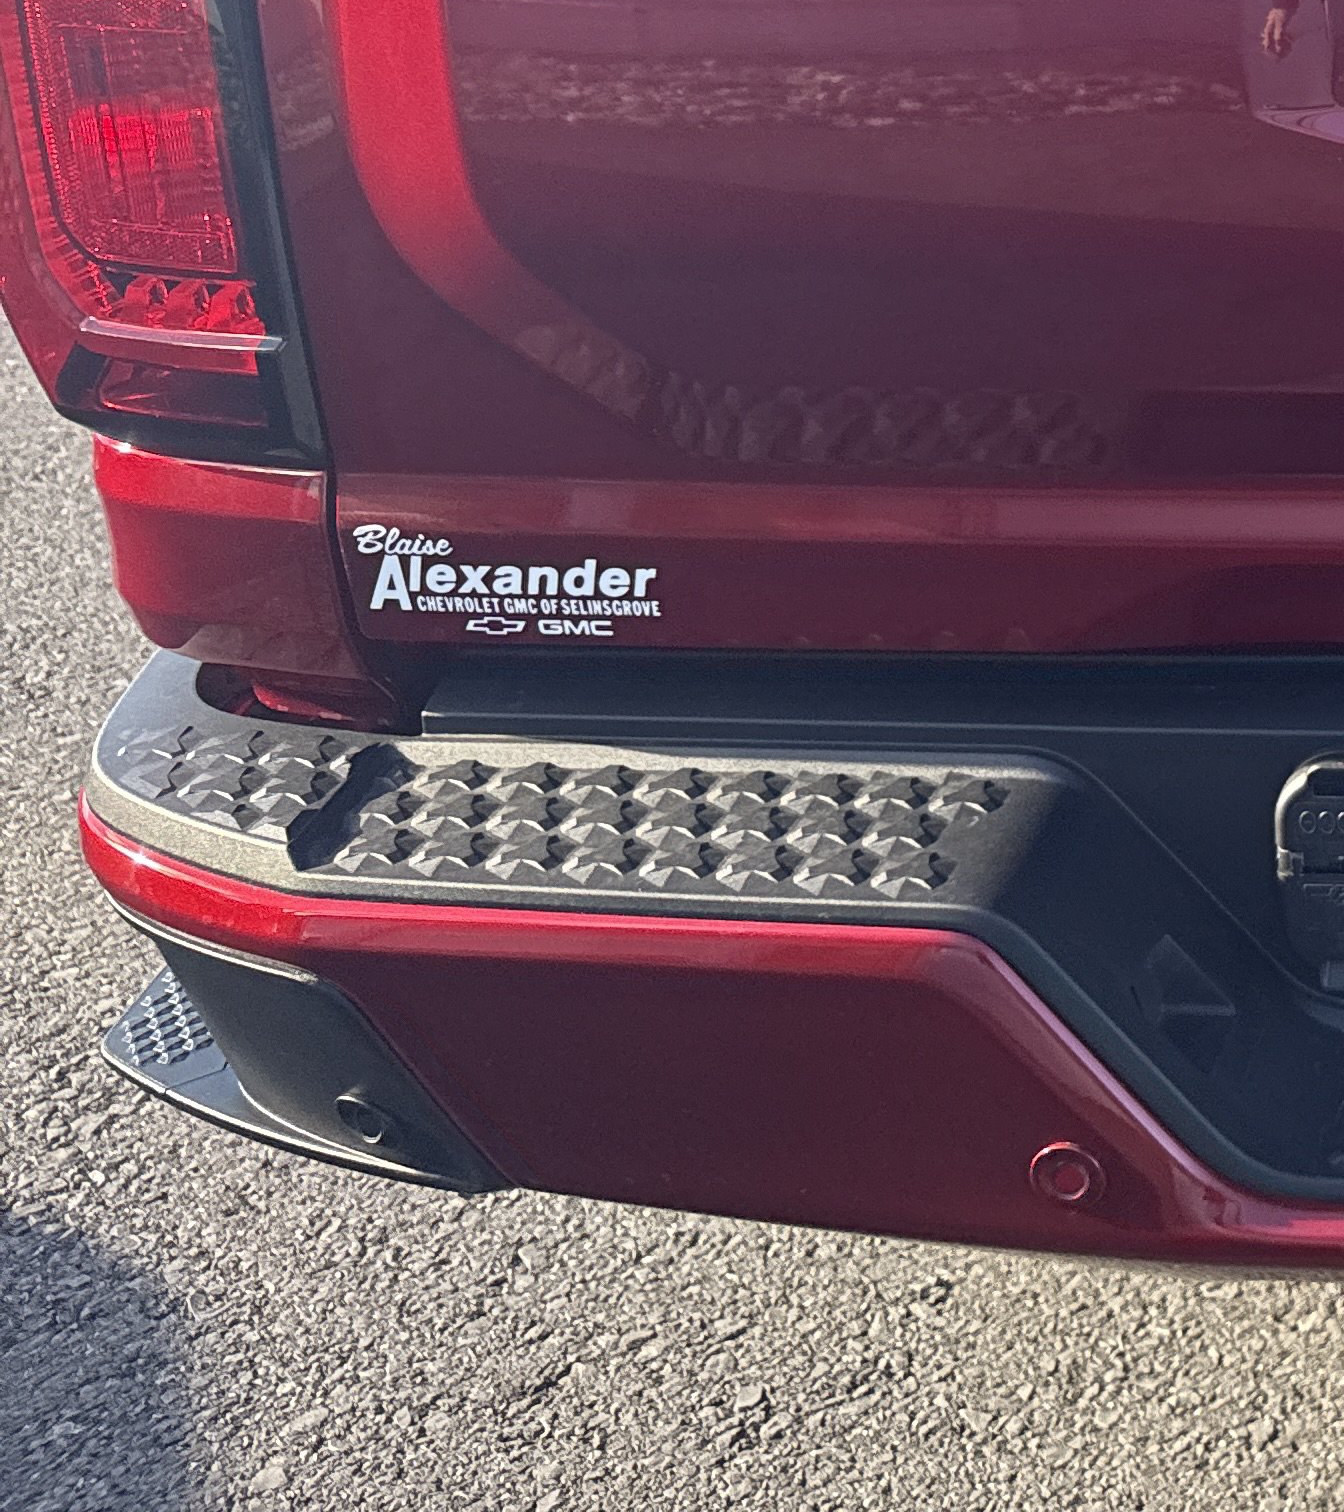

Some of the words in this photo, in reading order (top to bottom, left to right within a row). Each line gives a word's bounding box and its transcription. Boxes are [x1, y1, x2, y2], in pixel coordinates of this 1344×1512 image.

[353, 524, 453, 556] Blaise
[370, 554, 656, 610] Alexander
[417, 595, 500, 613] CHEVROLET
[504, 597, 537, 614] GMC
[541, 598, 558, 615] OF
[560, 599, 662, 617] SELINSGROVE
[538, 619, 614, 636] GMC
